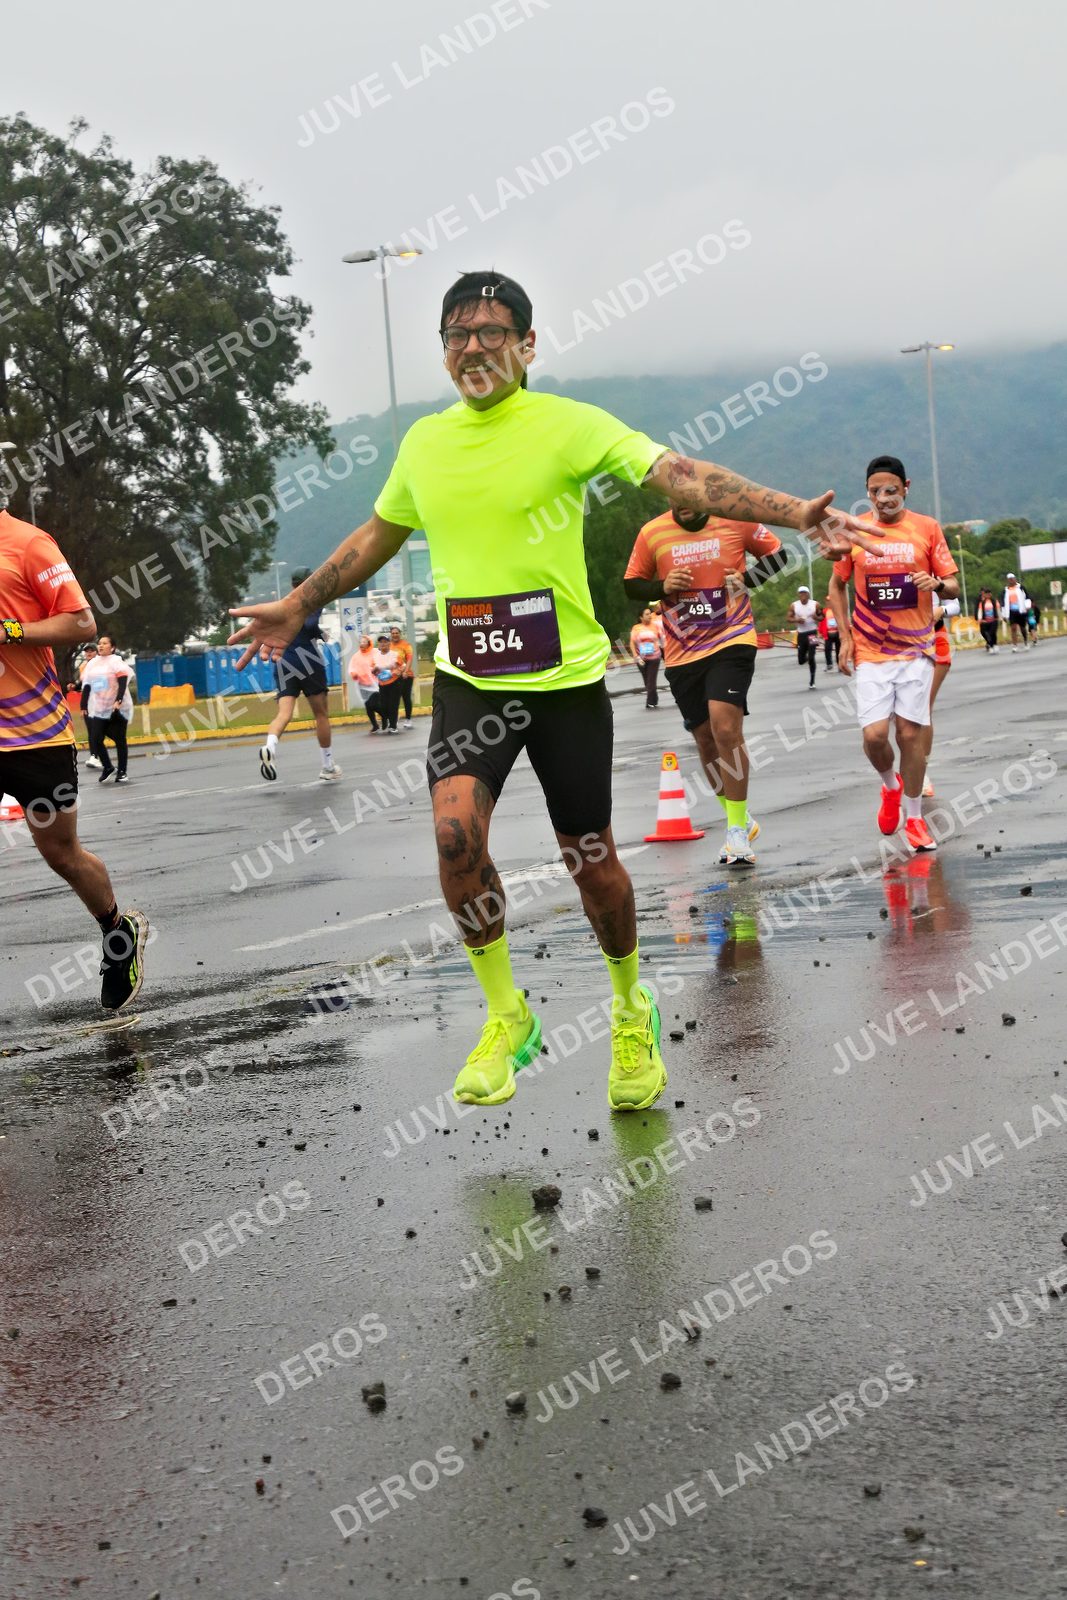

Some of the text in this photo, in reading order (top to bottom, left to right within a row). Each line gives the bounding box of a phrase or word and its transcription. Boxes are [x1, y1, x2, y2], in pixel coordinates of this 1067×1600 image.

[671, 538, 720, 557] CARRERA
[865, 543, 914, 557] RRERA
[878, 588, 902, 600] 357
[451, 603, 493, 617] CARRERA
[689, 604, 713, 615] 495
[472, 628, 523, 654] 364
